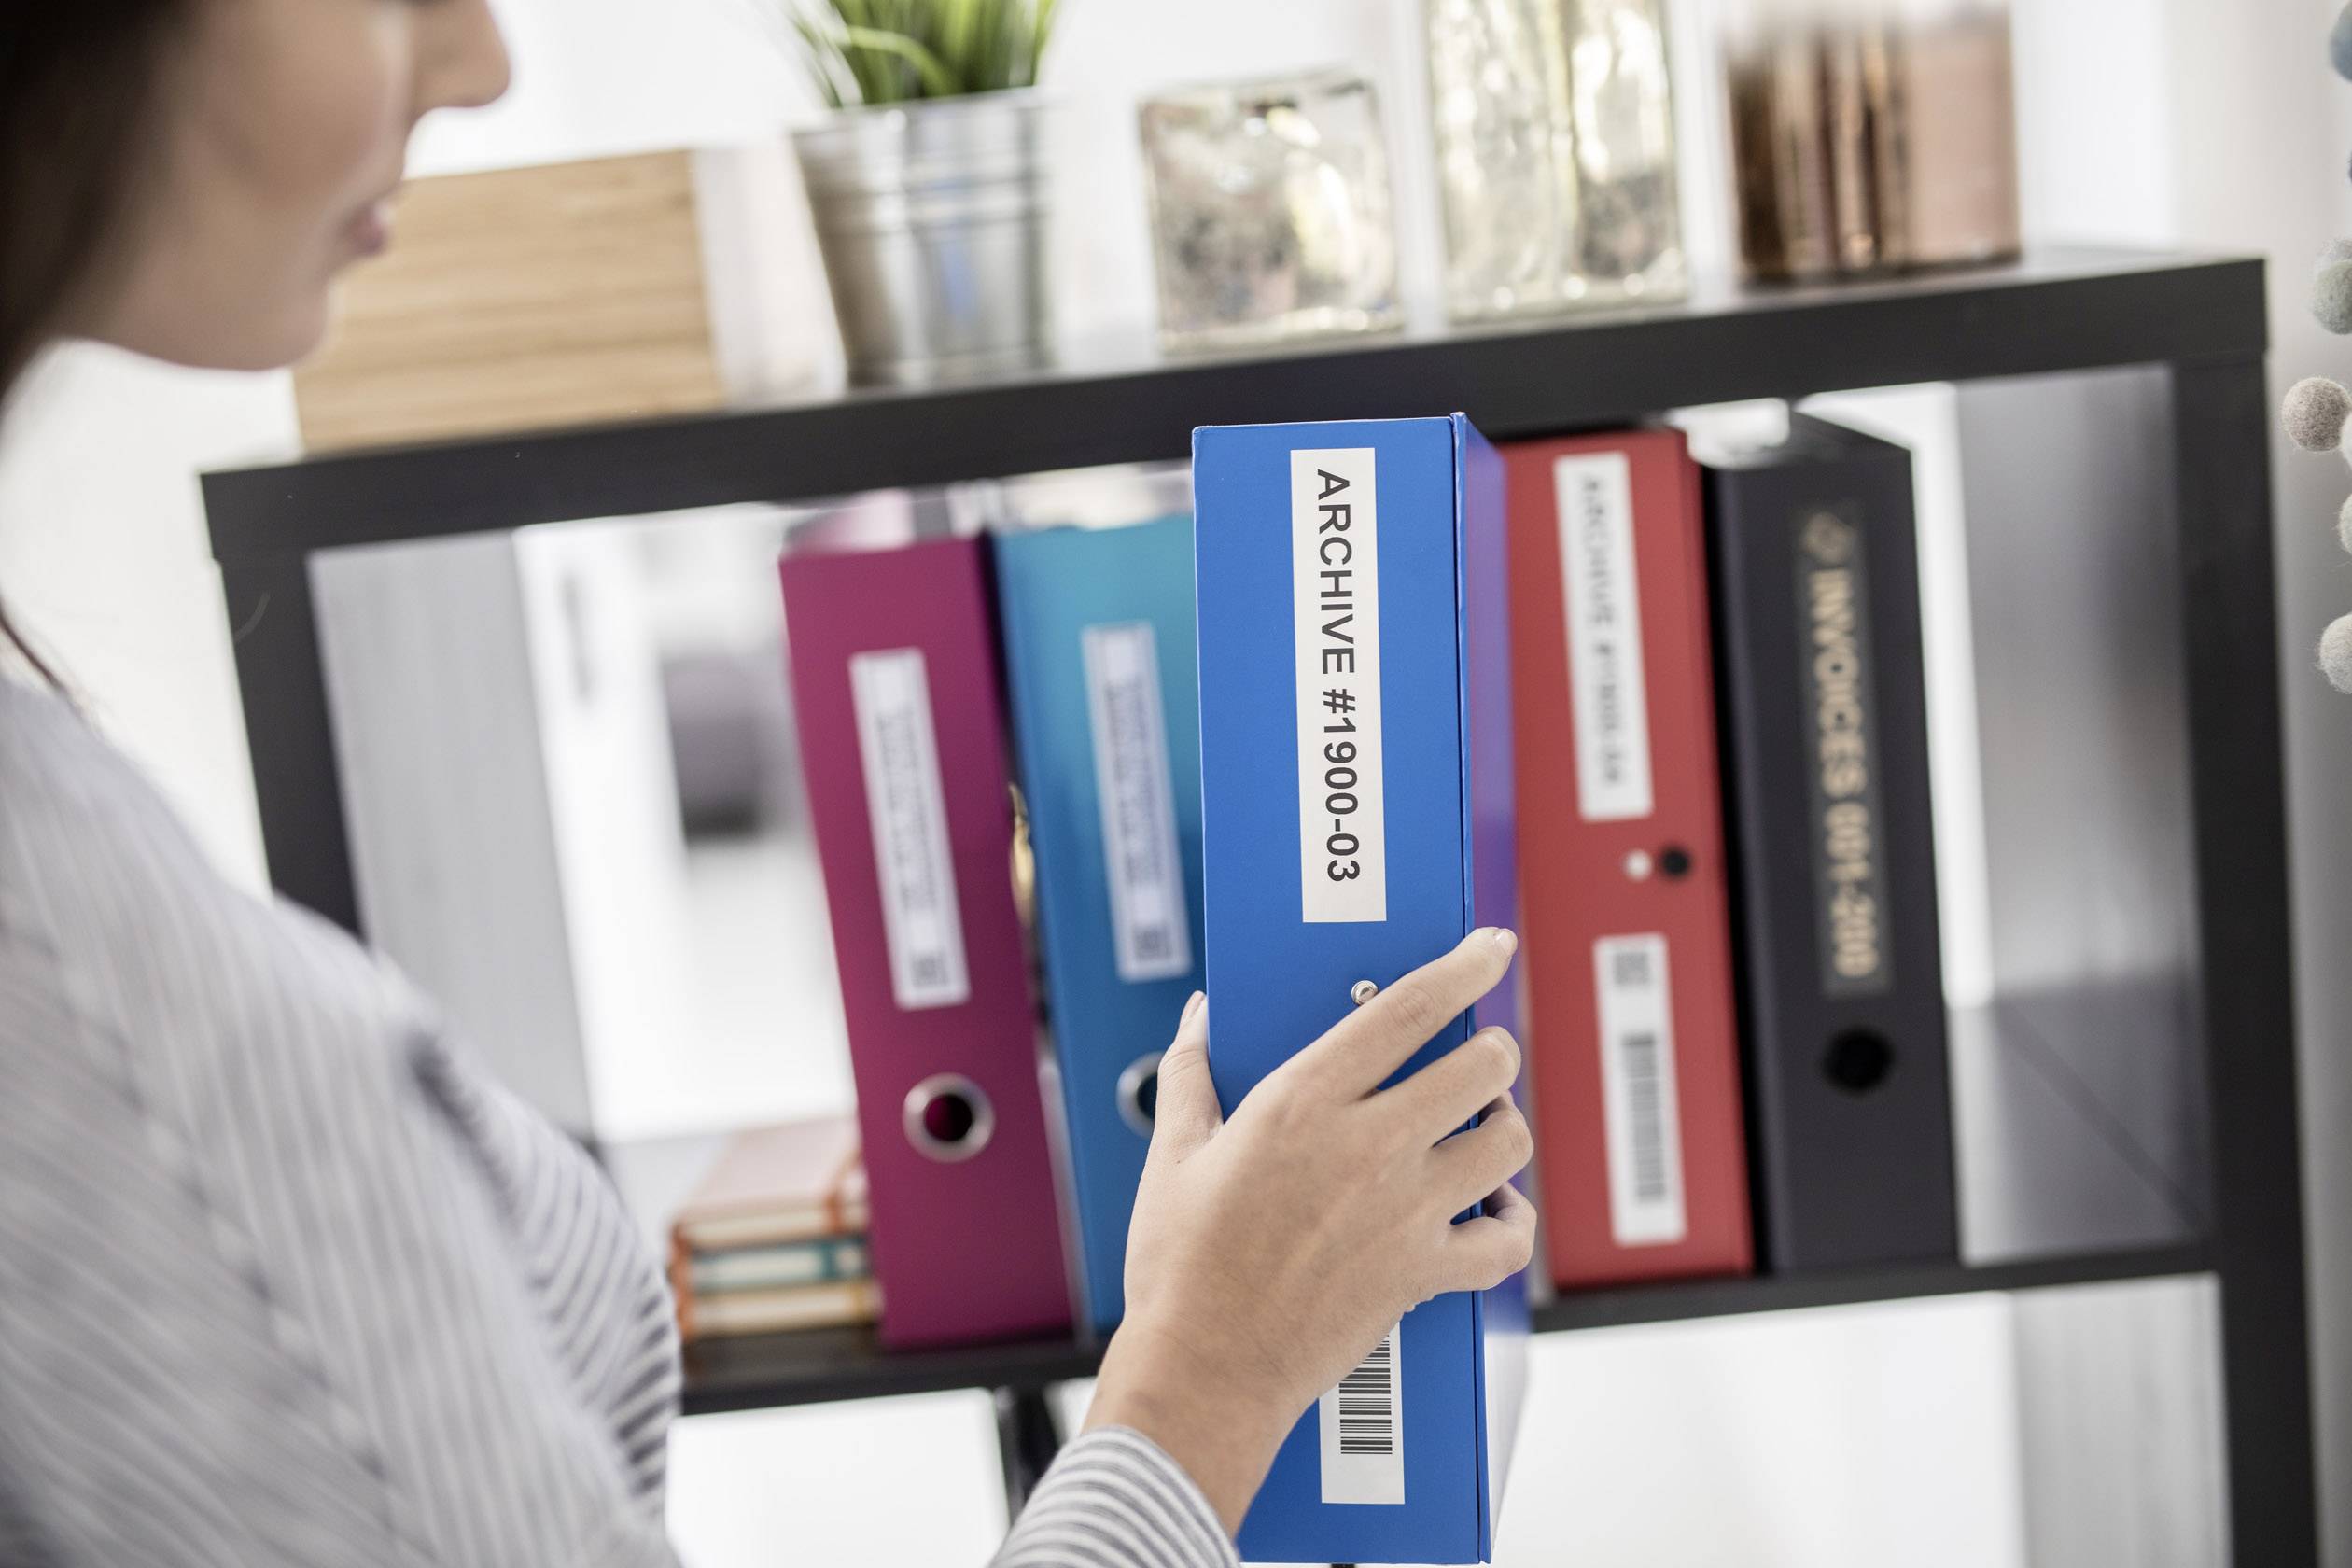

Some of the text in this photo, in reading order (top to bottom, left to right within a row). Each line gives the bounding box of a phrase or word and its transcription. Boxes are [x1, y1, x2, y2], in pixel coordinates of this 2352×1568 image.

[1317, 469, 1361, 882] ARCHIVE #1900-03
[1810, 569, 1867, 798] INVOICES
